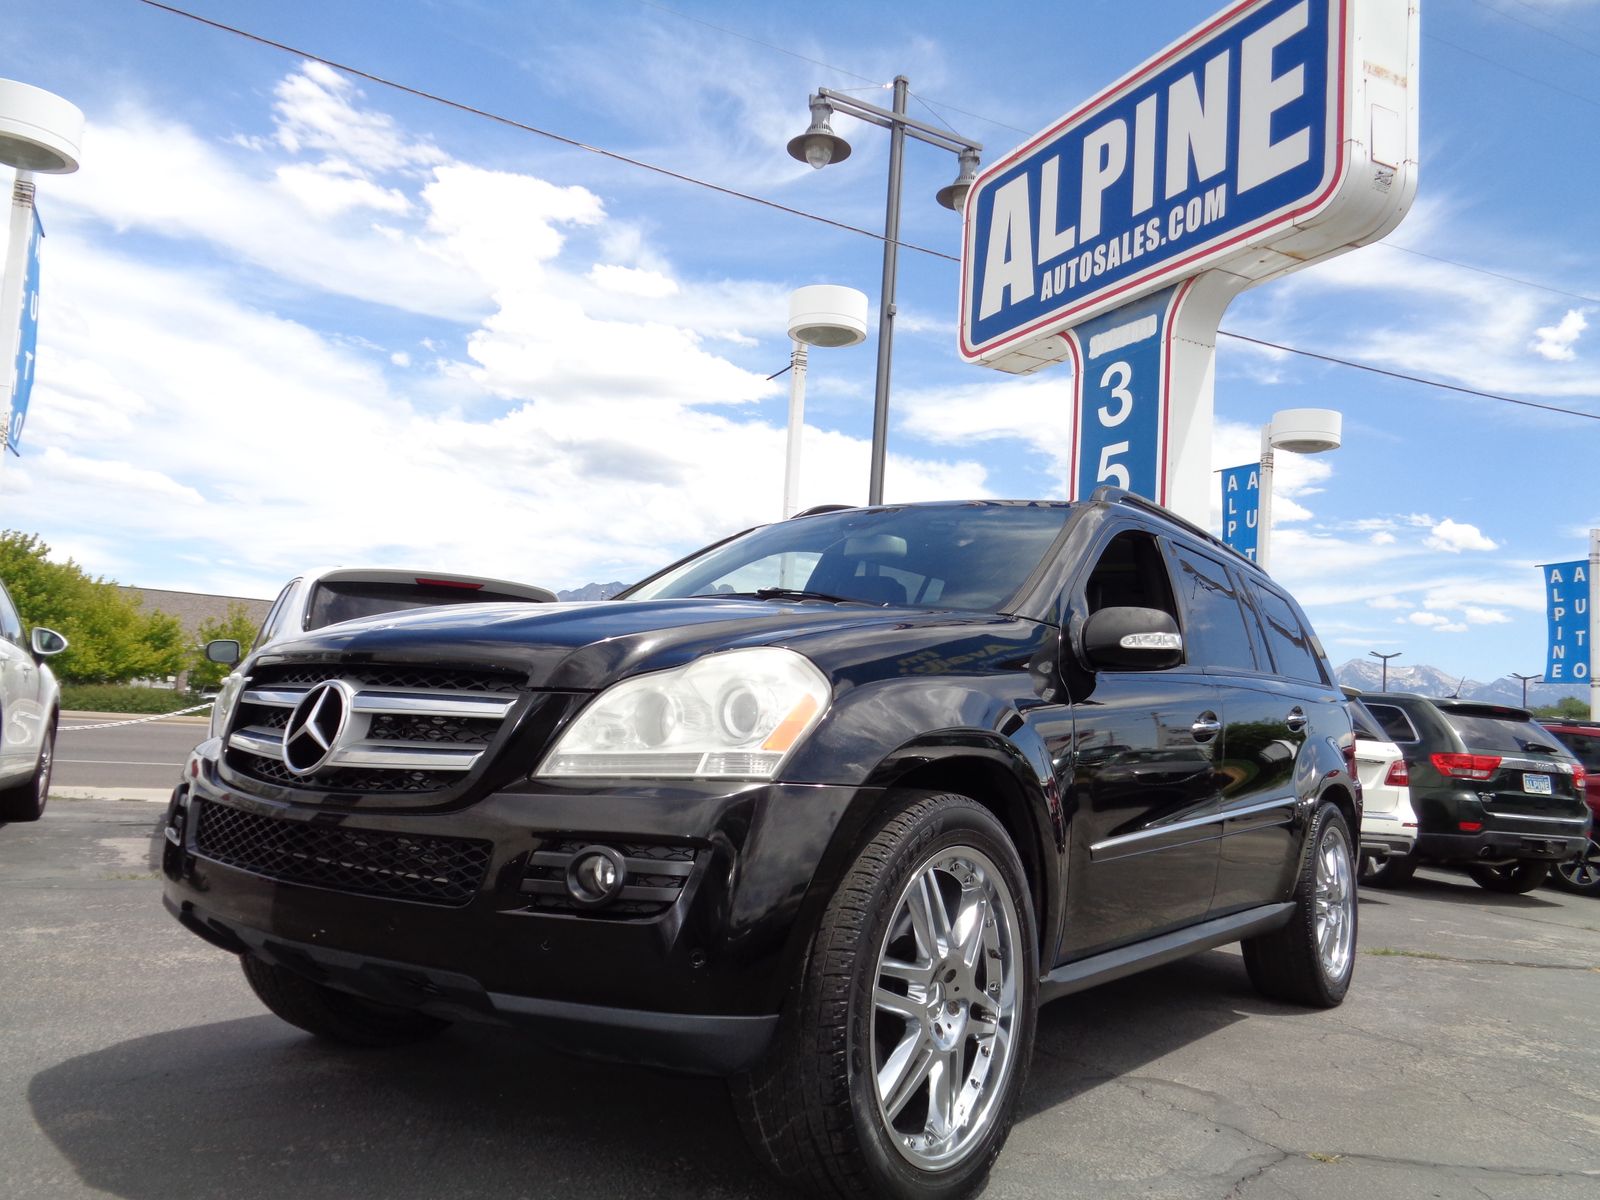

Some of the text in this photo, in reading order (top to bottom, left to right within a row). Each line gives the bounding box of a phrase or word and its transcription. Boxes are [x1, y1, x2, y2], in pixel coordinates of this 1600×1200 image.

[978, 0, 1310, 321] ALPINE
[1040, 183, 1226, 302] AUTOSALES.COM
[1227, 474, 1238, 548] ALP
[1550, 568, 1565, 678] ALPINE
[1573, 566, 1587, 678] AUTO
